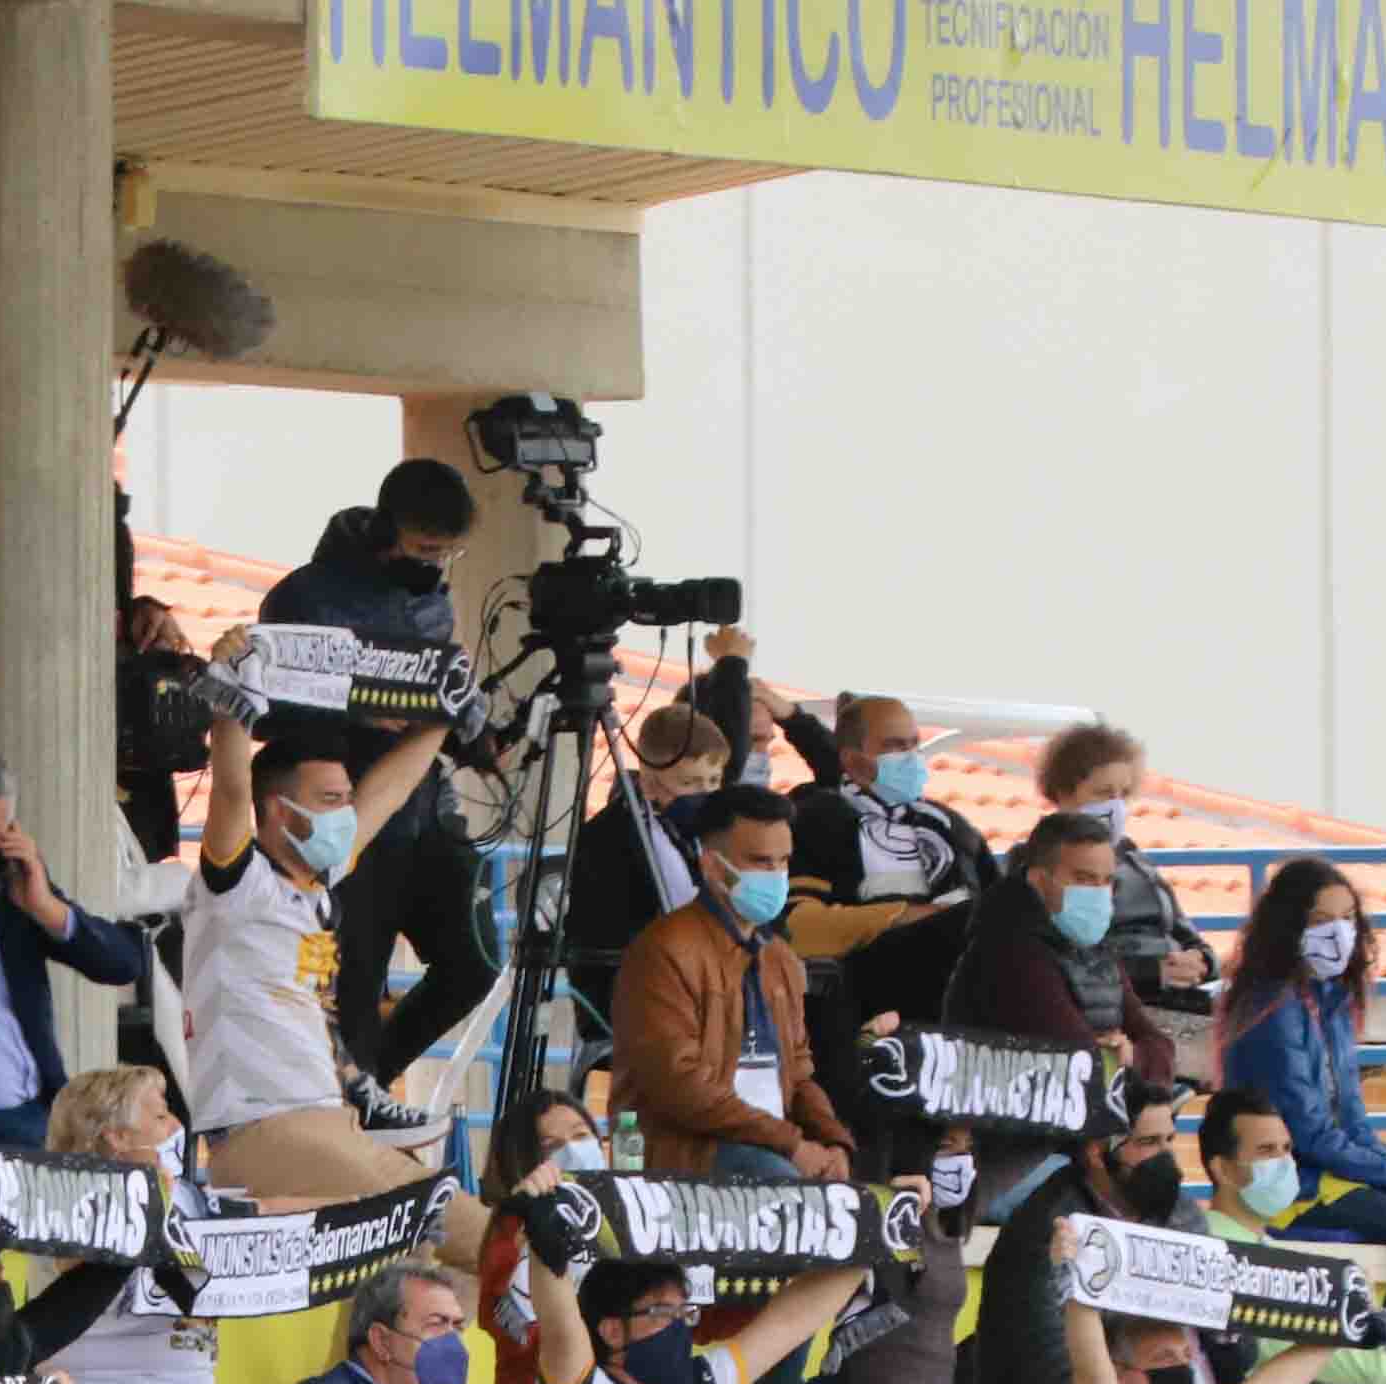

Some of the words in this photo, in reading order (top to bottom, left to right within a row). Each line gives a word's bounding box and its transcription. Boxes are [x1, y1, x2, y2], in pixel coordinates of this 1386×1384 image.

[930, 73, 1102, 137] PROFESIONAL
[919, 1033, 1094, 1131] UNIONISTAS
[614, 1176, 861, 1260] UNIONISTAS
